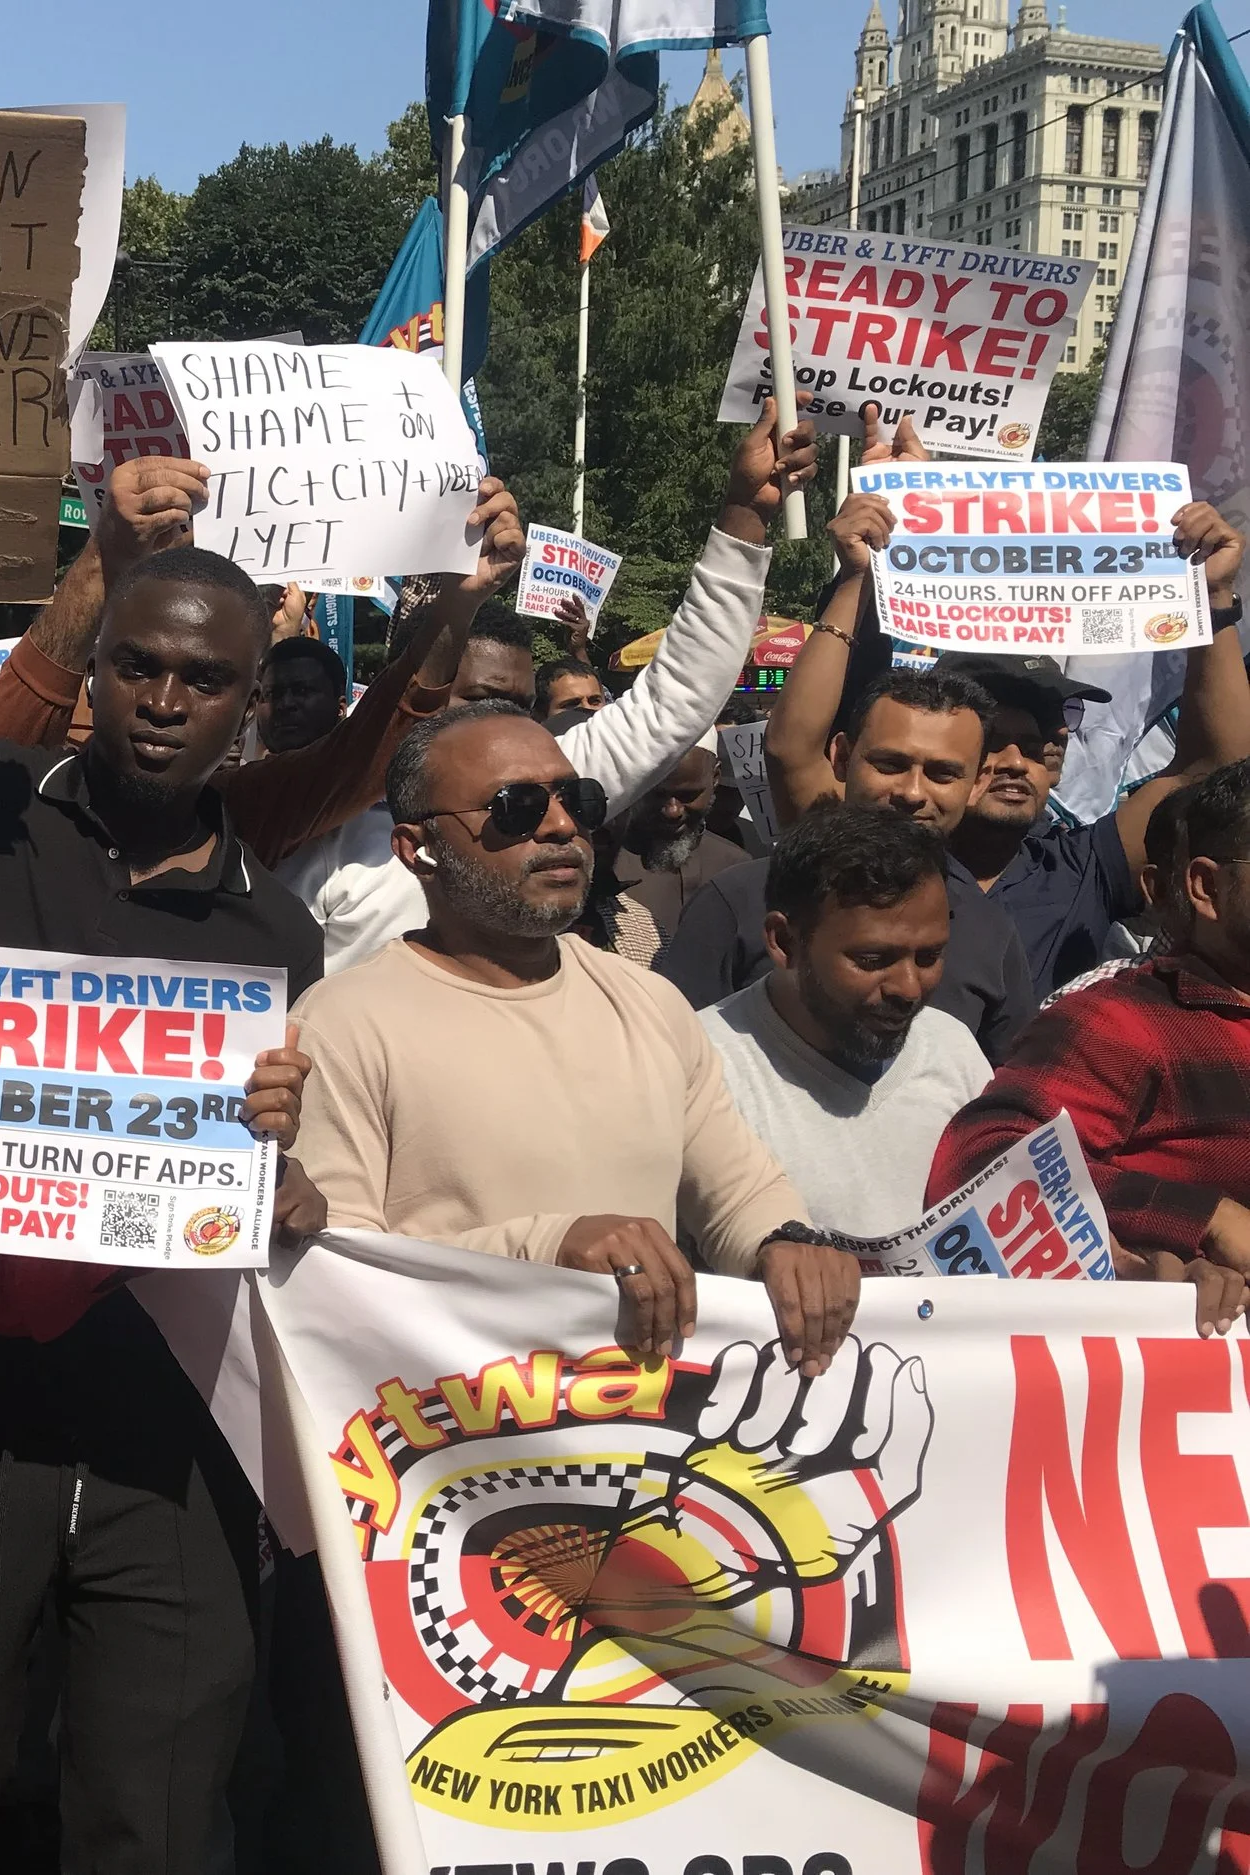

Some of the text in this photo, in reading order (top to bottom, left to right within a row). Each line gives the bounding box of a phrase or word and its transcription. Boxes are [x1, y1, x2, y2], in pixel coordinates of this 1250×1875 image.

[855, 238, 875, 259] &
[884, 240, 955, 268] LYFT
[959, 251, 1082, 286] DRIVERS
[783, 256, 1069, 327] READY TO
[100, 368, 117, 389] &
[182, 352, 351, 401] SHAME
[847, 367, 1015, 408] Lockouts!
[202, 402, 435, 452] SHAME ON
[752, 384, 847, 417] Rse
[923, 405, 999, 441] Pay!
[996, 450, 1024, 458] ALLIANCE
[860, 471, 1184, 494] UBER+LYFT DRIVERS
[902, 491, 1160, 535] STRIKE!
[227, 519, 343, 569] LYFT
[542, 543, 606, 584] STRIKE!
[582, 546, 618, 570] DRIVERS
[889, 541, 1180, 575] OCTOBER 23RD
[526, 592, 545, 603] END
[533, 567, 587, 593] OCTOBER
[871, 552, 889, 623] RESPECT THE
[893, 580, 1184, 602] 24-HOURS. TURN OFF APPS.
[1193, 580, 1202, 611] WORKERS
[524, 601, 550, 613] RAISE
[888, 596, 1072, 624] END LOCKOUTS!
[1196, 609, 1205, 636] ALLIANCE
[892, 614, 1066, 644] RAISE OUR PAY!
[71, 971, 272, 1013] DRIVERS
[126, 1092, 246, 1140] 23RD
[2, 1141, 83, 1174] TURN
[91, 1150, 151, 1180] OFF
[156, 1157, 244, 1187] APPS.
[261, 1140, 269, 1160] TAXI
[257, 1160, 268, 1206] WORKERS
[904, 1213, 938, 1241] THE
[938, 1156, 1010, 1218] DRIVERS!
[0, 1207, 77, 1241] PAY!
[164, 1195, 177, 1260] Sign Strike Pledge
[251, 1207, 264, 1251] ALLIANCE
[329, 1345, 674, 1561] ytwa
[1008, 1335, 1250, 1660] NE
[411, 1675, 892, 1816] NEW YORK TAXI WORKERS ALLIANCE
